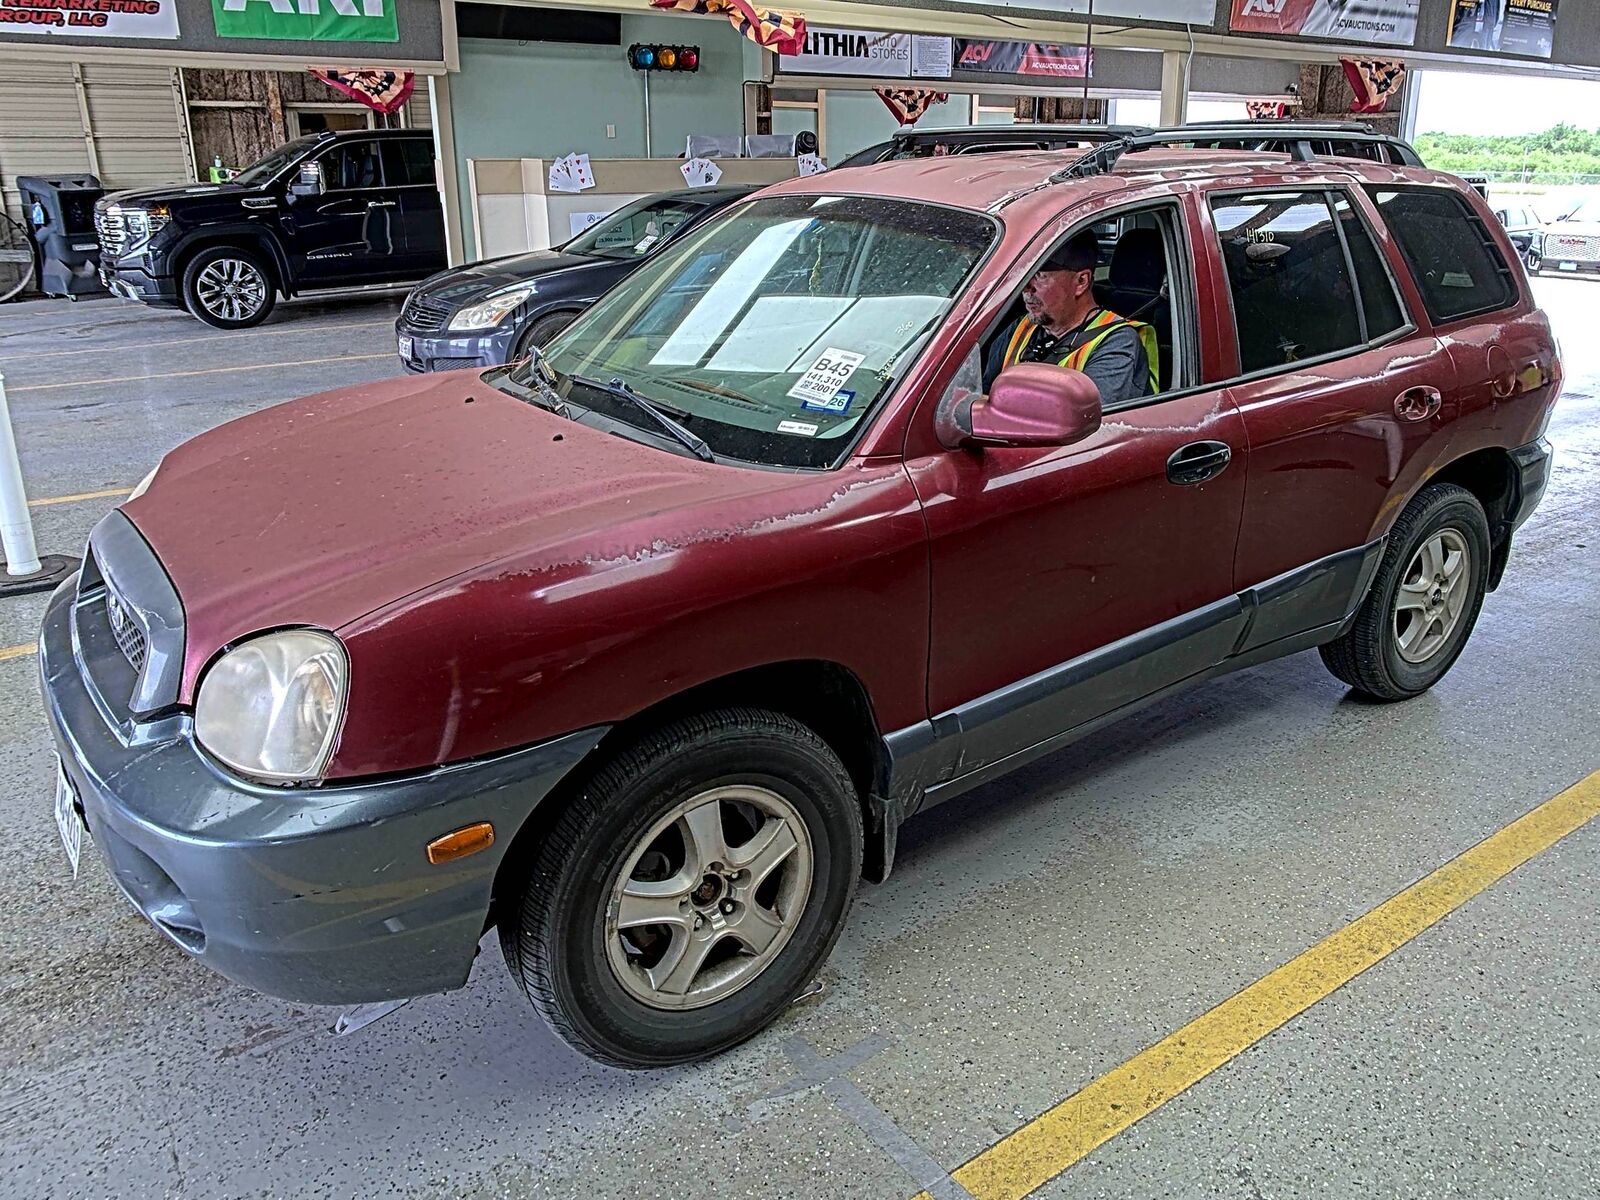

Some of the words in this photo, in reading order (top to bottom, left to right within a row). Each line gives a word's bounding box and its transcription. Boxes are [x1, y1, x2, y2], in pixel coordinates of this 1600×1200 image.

[68, 12, 108, 27] LLC
[803, 31, 869, 58] LITHIA
[872, 36, 897, 48] AUTO
[872, 48, 909, 60] STORES
[814, 358, 854, 377] B45
[811, 382, 835, 395] 2001
